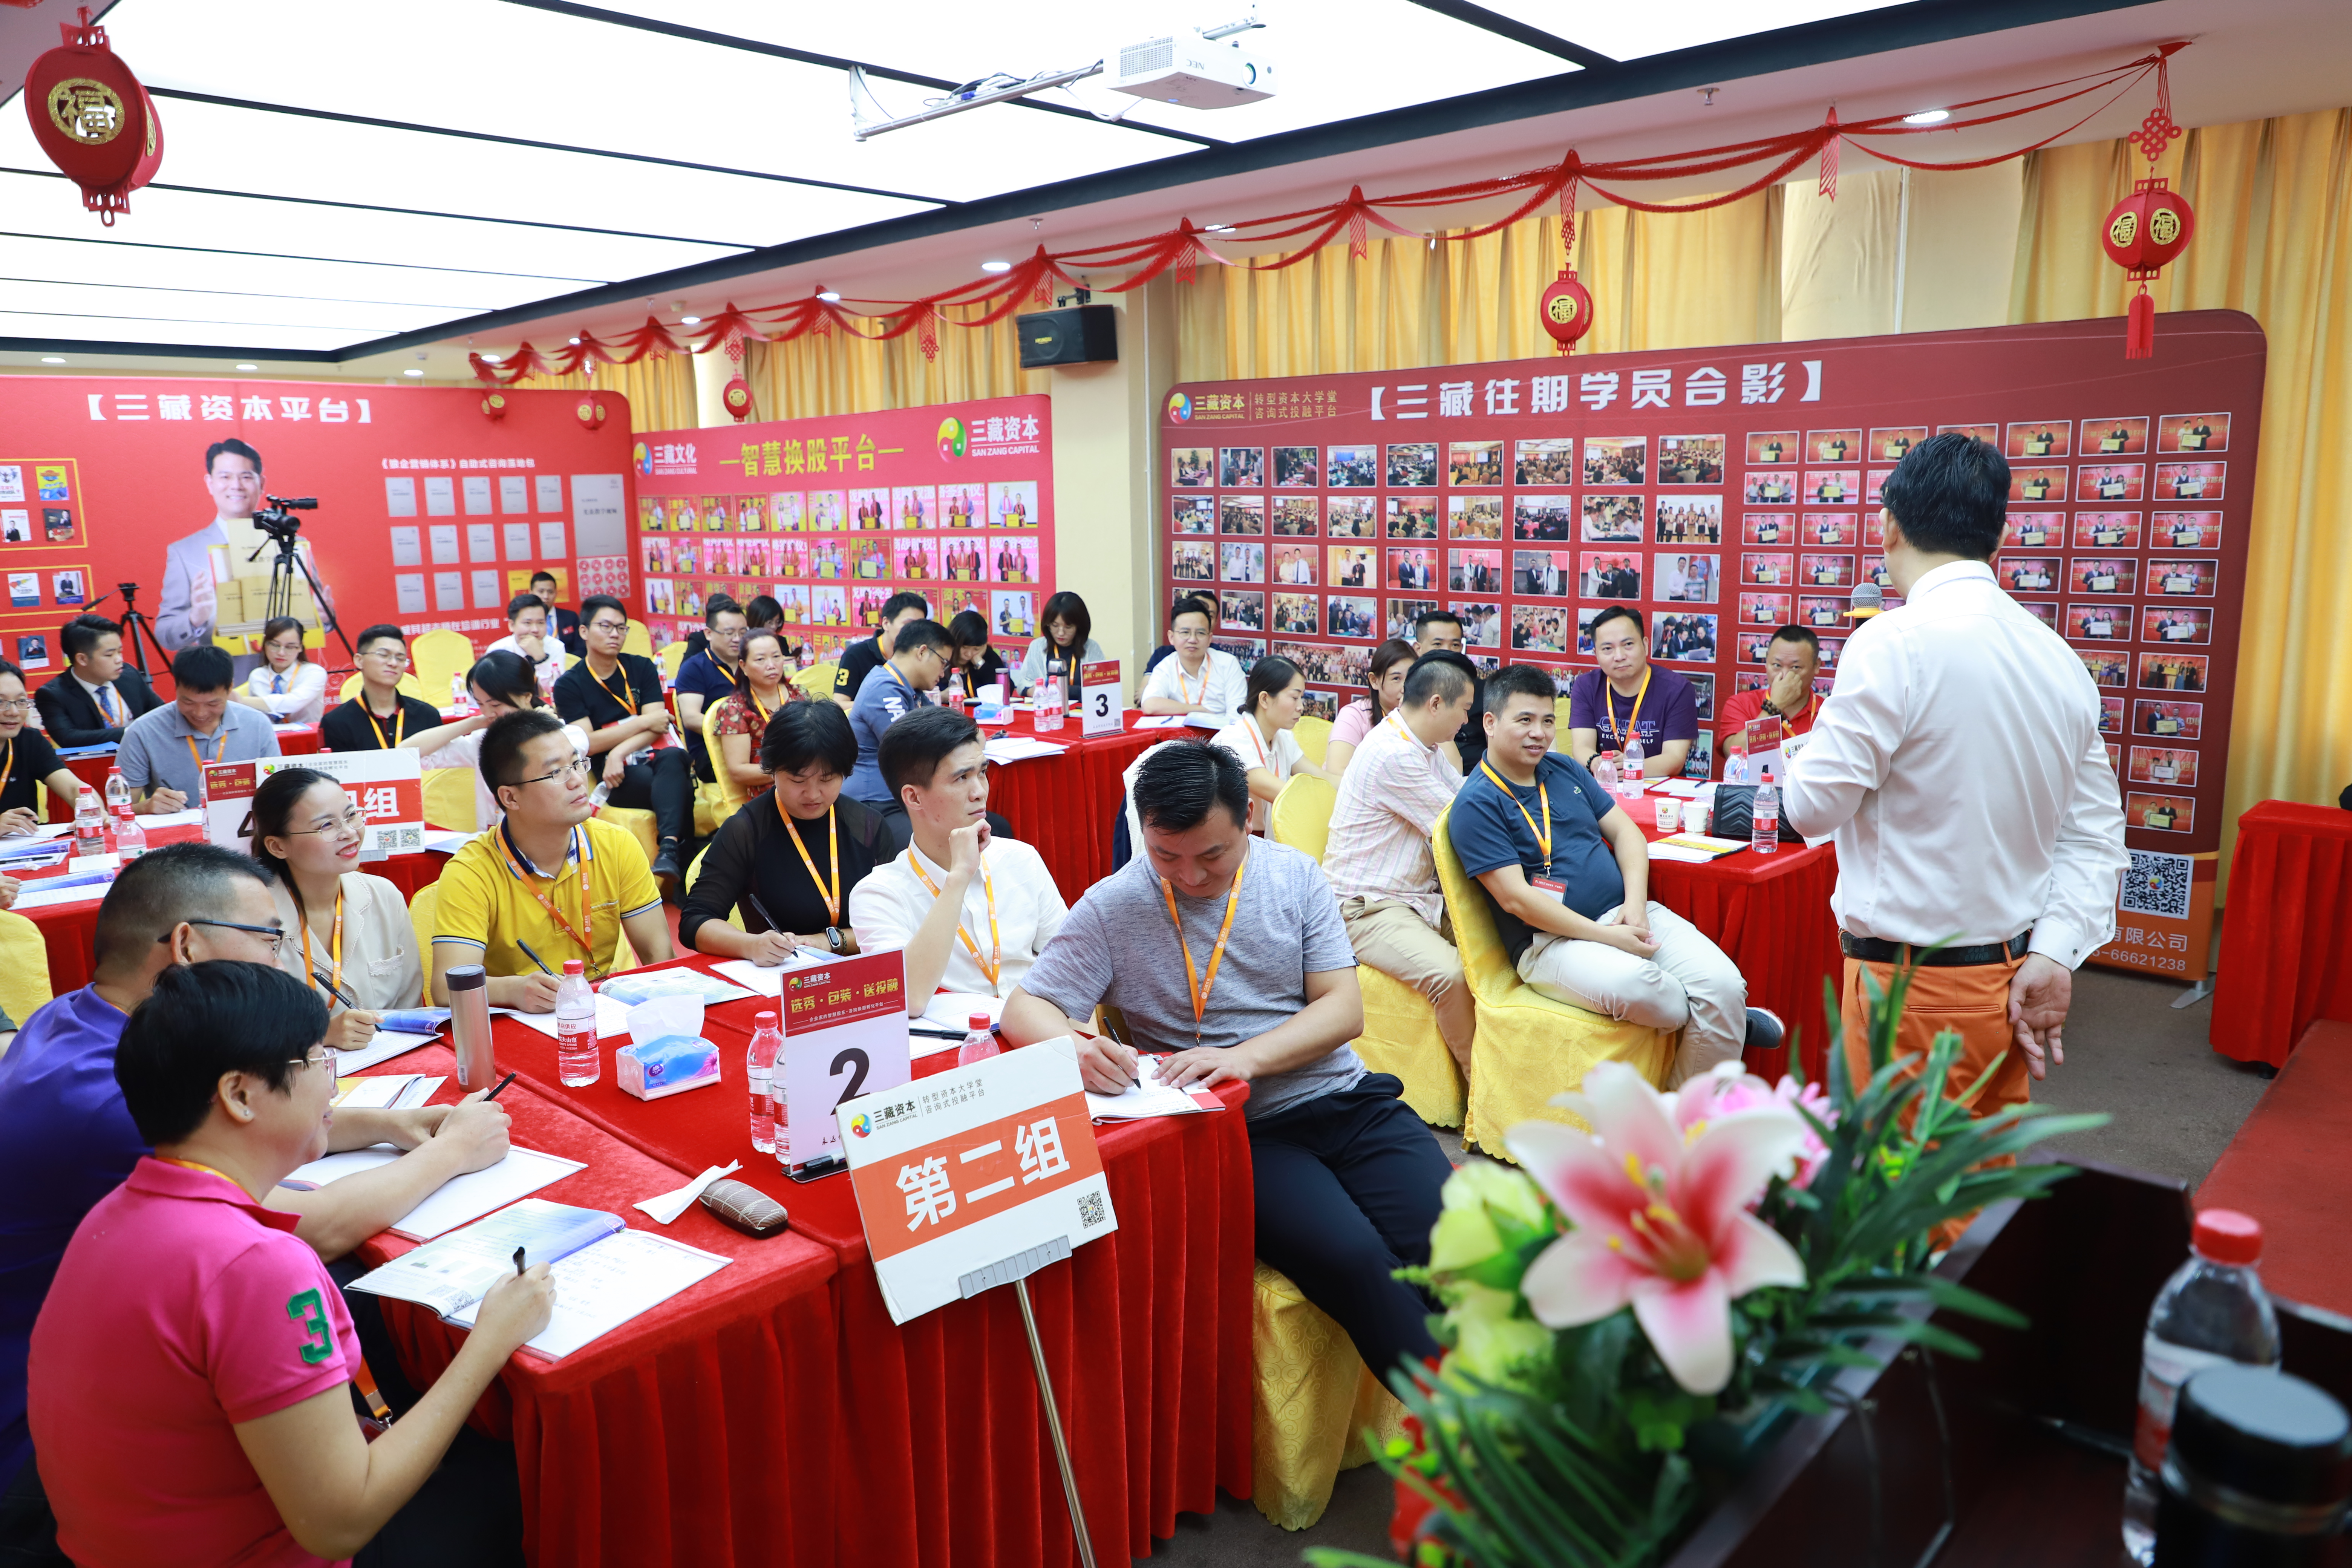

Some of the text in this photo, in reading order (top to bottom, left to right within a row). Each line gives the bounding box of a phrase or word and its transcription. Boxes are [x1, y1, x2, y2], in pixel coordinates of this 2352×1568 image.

[1186, 58, 1204, 70] NEC
[1254, 390, 1337, 406] 转型资本大学堂
[1371, 360, 1822, 421] 【三藏往期学员合影】
[87, 393, 372, 424] 【三藏资本平台】
[1194, 393, 1245, 411] 三藏资本
[1254, 404, 1337, 420] 咨询式投融平台
[971, 414, 1040, 442] 三藏资本
[653, 443, 697, 464] 三藏文化
[971, 444, 1040, 457] SAN ZANG CAPITAL
[836, 668, 850, 686] 3
[1095, 694, 1109, 717] 3
[1602, 733, 1625, 742] EXCD
[803, 972, 831, 984] 三藏资本
[829, 1047, 871, 1116] 2
[922, 1078, 984, 1105] 转型资本大学堂
[873, 1099, 916, 1123] 三藏资本
[925, 1088, 986, 1115] 咨询式投融平台
[886, 1119, 899, 1128] ZANG
[899, 1114, 918, 1124] CAPITAL
[896, 1116, 1070, 1233] 第二组
[286, 1287, 333, 1364] 3
